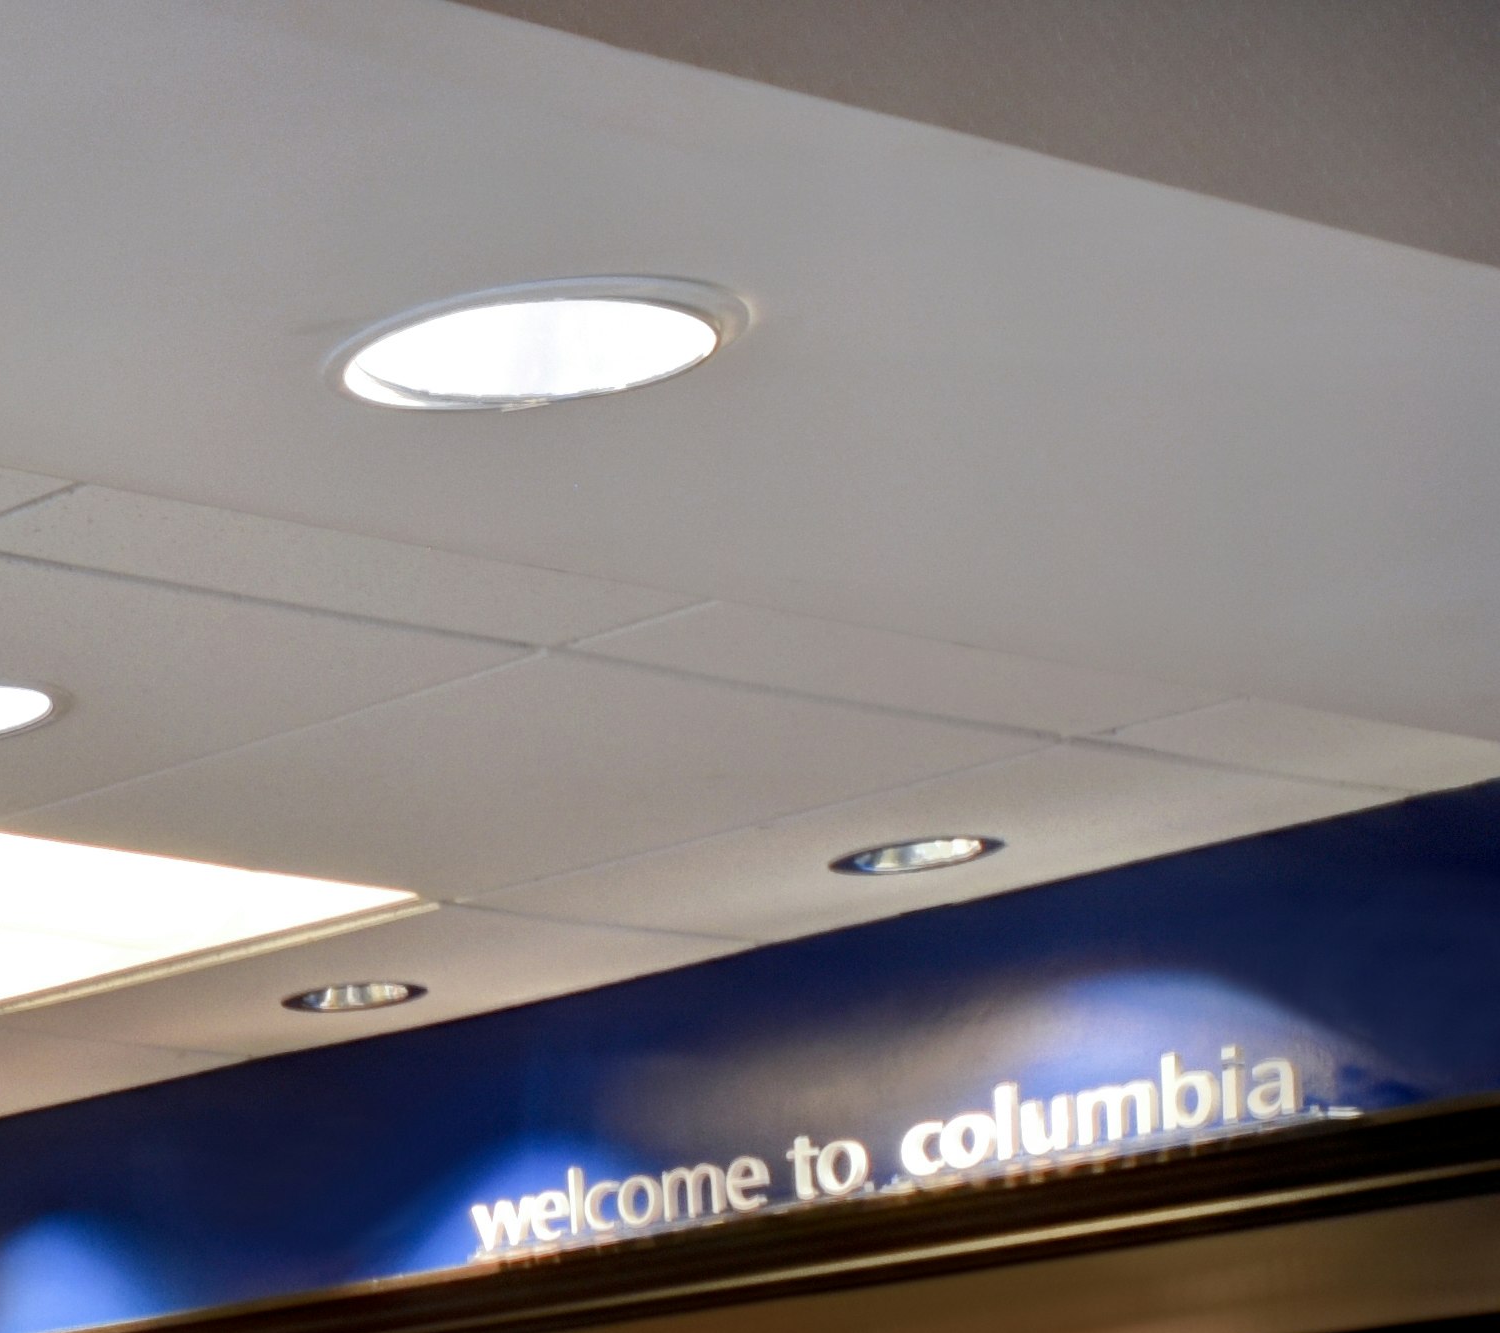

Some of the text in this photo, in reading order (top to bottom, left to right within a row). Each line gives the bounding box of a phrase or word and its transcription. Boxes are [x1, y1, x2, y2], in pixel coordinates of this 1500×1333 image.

[470, 1044, 1299, 1258] welcome to columbia
